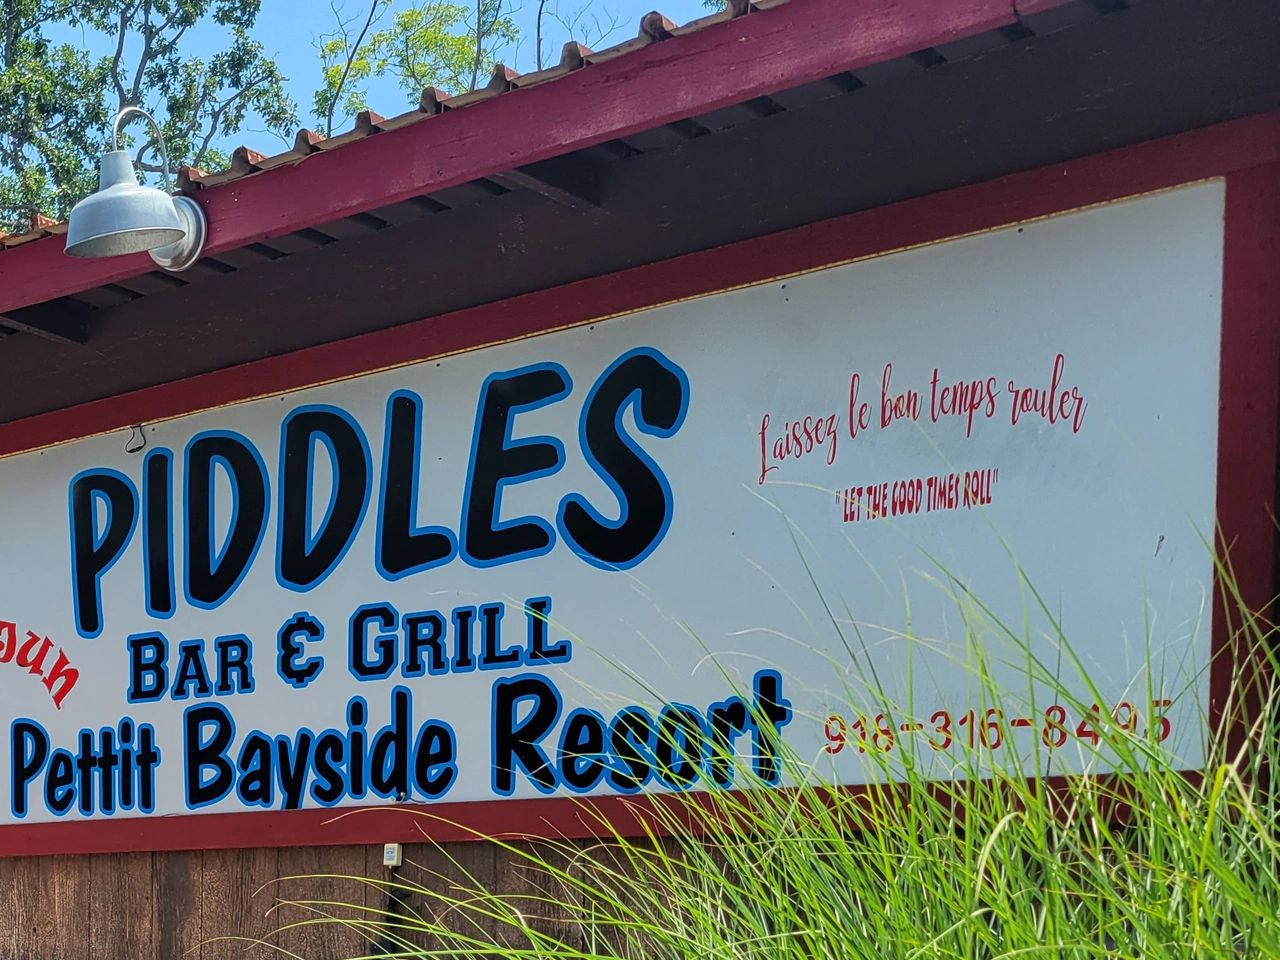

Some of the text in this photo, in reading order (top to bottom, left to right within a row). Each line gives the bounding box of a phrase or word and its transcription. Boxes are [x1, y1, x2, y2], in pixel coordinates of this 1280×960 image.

[758, 353, 1089, 485] Laissez le bon temps rouler
[69, 346, 691, 638] PIDDLES
[866, 482, 888, 520] THE
[891, 478, 923, 517] GOOD
[926, 472, 960, 513] TIMES
[127, 596, 572, 704] BAR & GRILL
[10, 669, 792, 819] Pettit Bayside Resort
